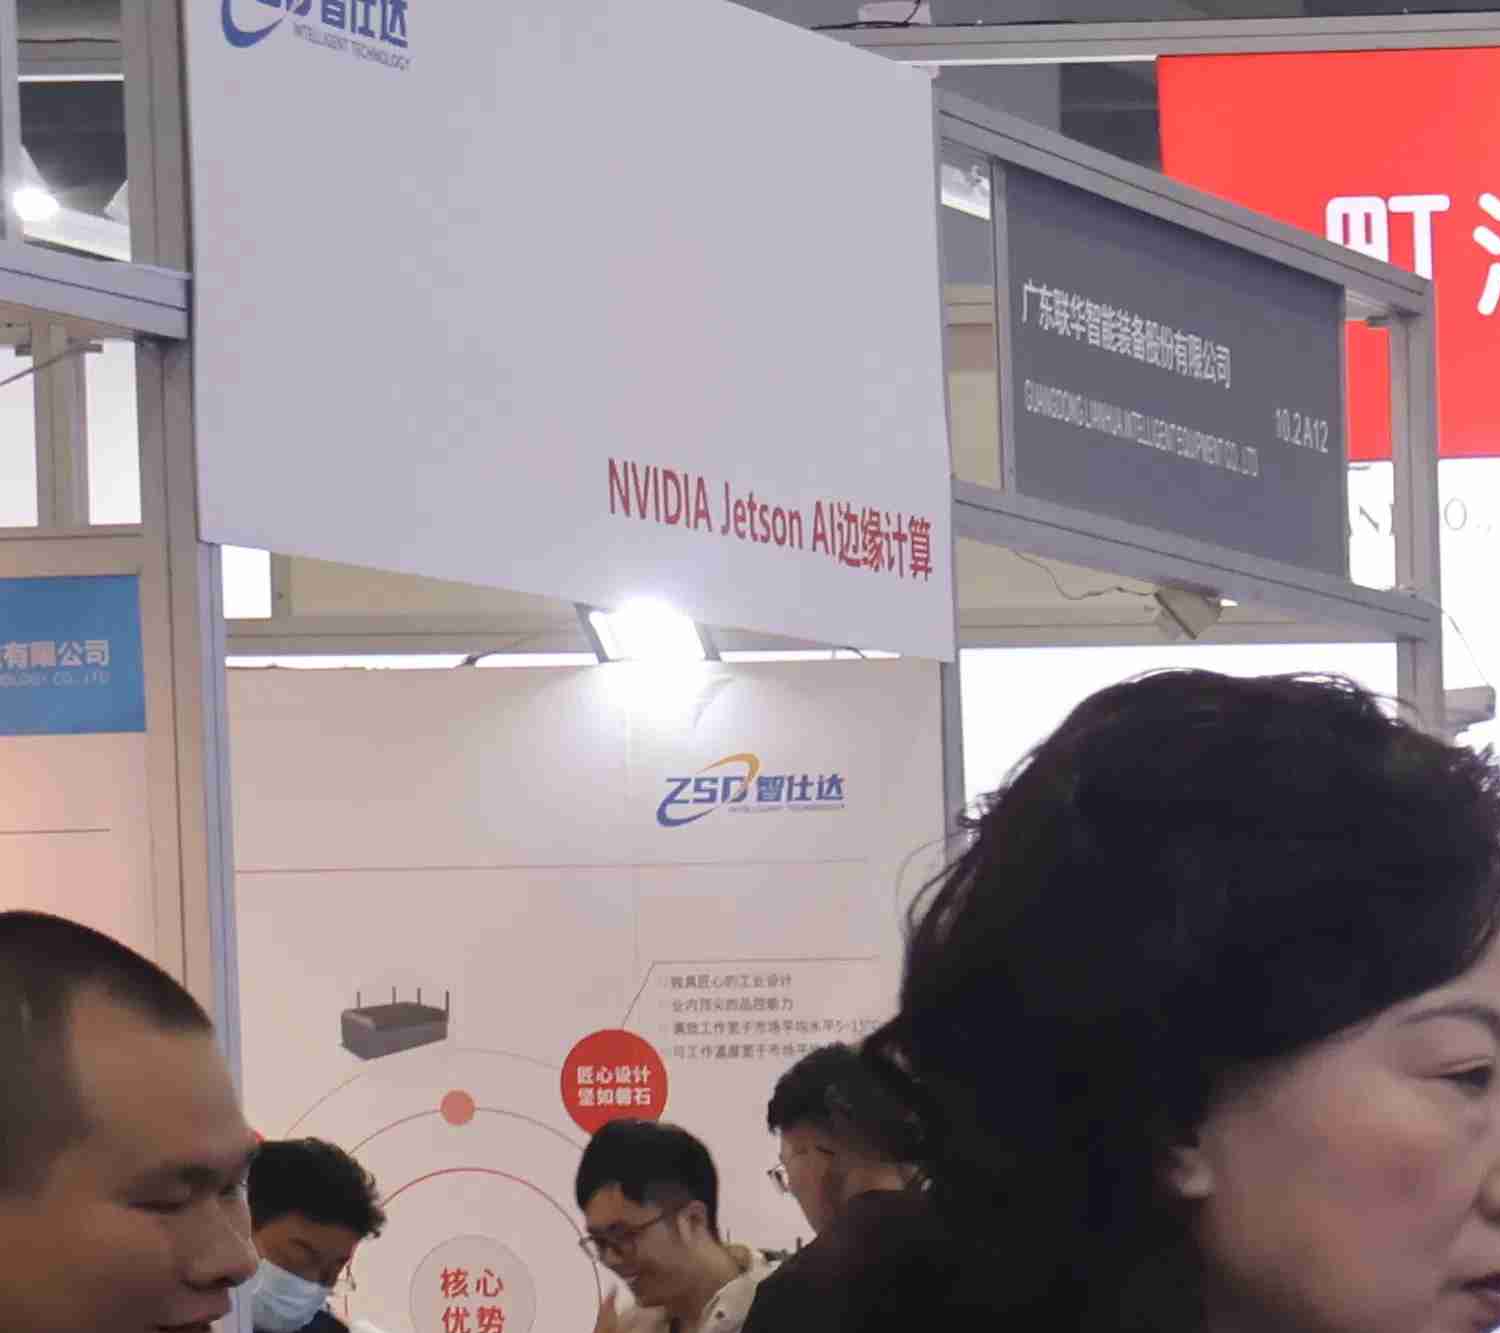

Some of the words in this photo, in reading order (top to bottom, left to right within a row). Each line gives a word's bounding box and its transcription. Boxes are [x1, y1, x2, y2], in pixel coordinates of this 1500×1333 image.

[608, 457, 713, 533] NVIDIA
[721, 480, 803, 550] Jetson
[812, 499, 933, 582] AI边缘计算
[1443, 497, 1493, 534] O.,
[0, 640, 110, 669] 有限公司
[756, 773, 845, 801] 智仕达
[577, 1064, 652, 1086] 匠心设计
[440, 1266, 504, 1298] 核心
